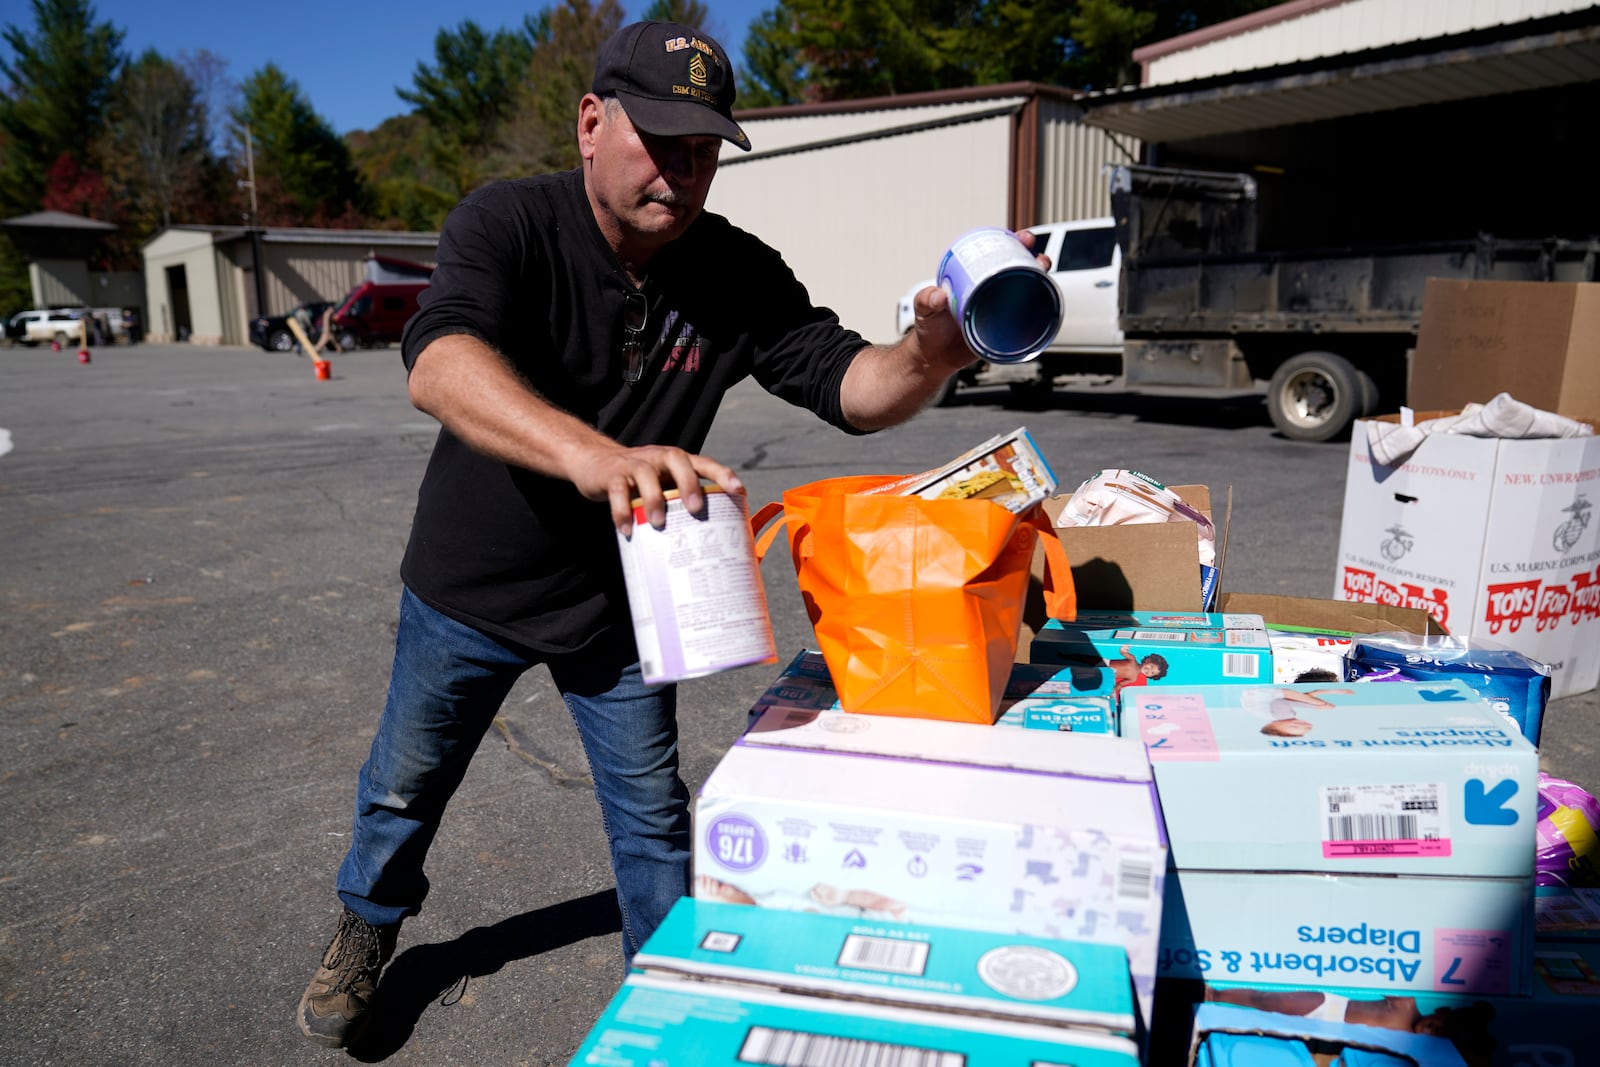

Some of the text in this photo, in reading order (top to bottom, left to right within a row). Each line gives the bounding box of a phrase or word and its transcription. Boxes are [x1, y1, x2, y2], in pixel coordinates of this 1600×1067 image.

[665, 37, 690, 52] U.S.
[672, 85, 690, 95] CSM
[1420, 464, 1447, 477] TOYS
[1447, 468, 1477, 481] ONLY
[1504, 468, 1597, 486] NEW, UNWRAPPED
[1490, 562, 1512, 574] U.S.
[1514, 560, 1559, 573] MARINE
[1559, 554, 1586, 568] CORPS
[1387, 565, 1415, 579] CORPS
[1416, 573, 1457, 588] RESERVE
[1345, 571, 1444, 623] TOYS FOR TOTS
[1490, 584, 1600, 616] TOYS FOR TOTS
[1030, 714, 1101, 722] DIAPERS
[1148, 737, 1174, 749] 7
[1396, 729, 1507, 738] Diapers
[1268, 738, 1514, 749] Absorbent & Soft
[718, 835, 754, 864] 176
[852, 925, 931, 941] SOLD AS SET
[1297, 922, 1421, 954] Diapers
[1157, 947, 1422, 982] Absorbent & Sof
[1440, 956, 1466, 985] 7
[841, 969, 890, 984] COMME
[892, 976, 963, 993] ENSEMBLE
